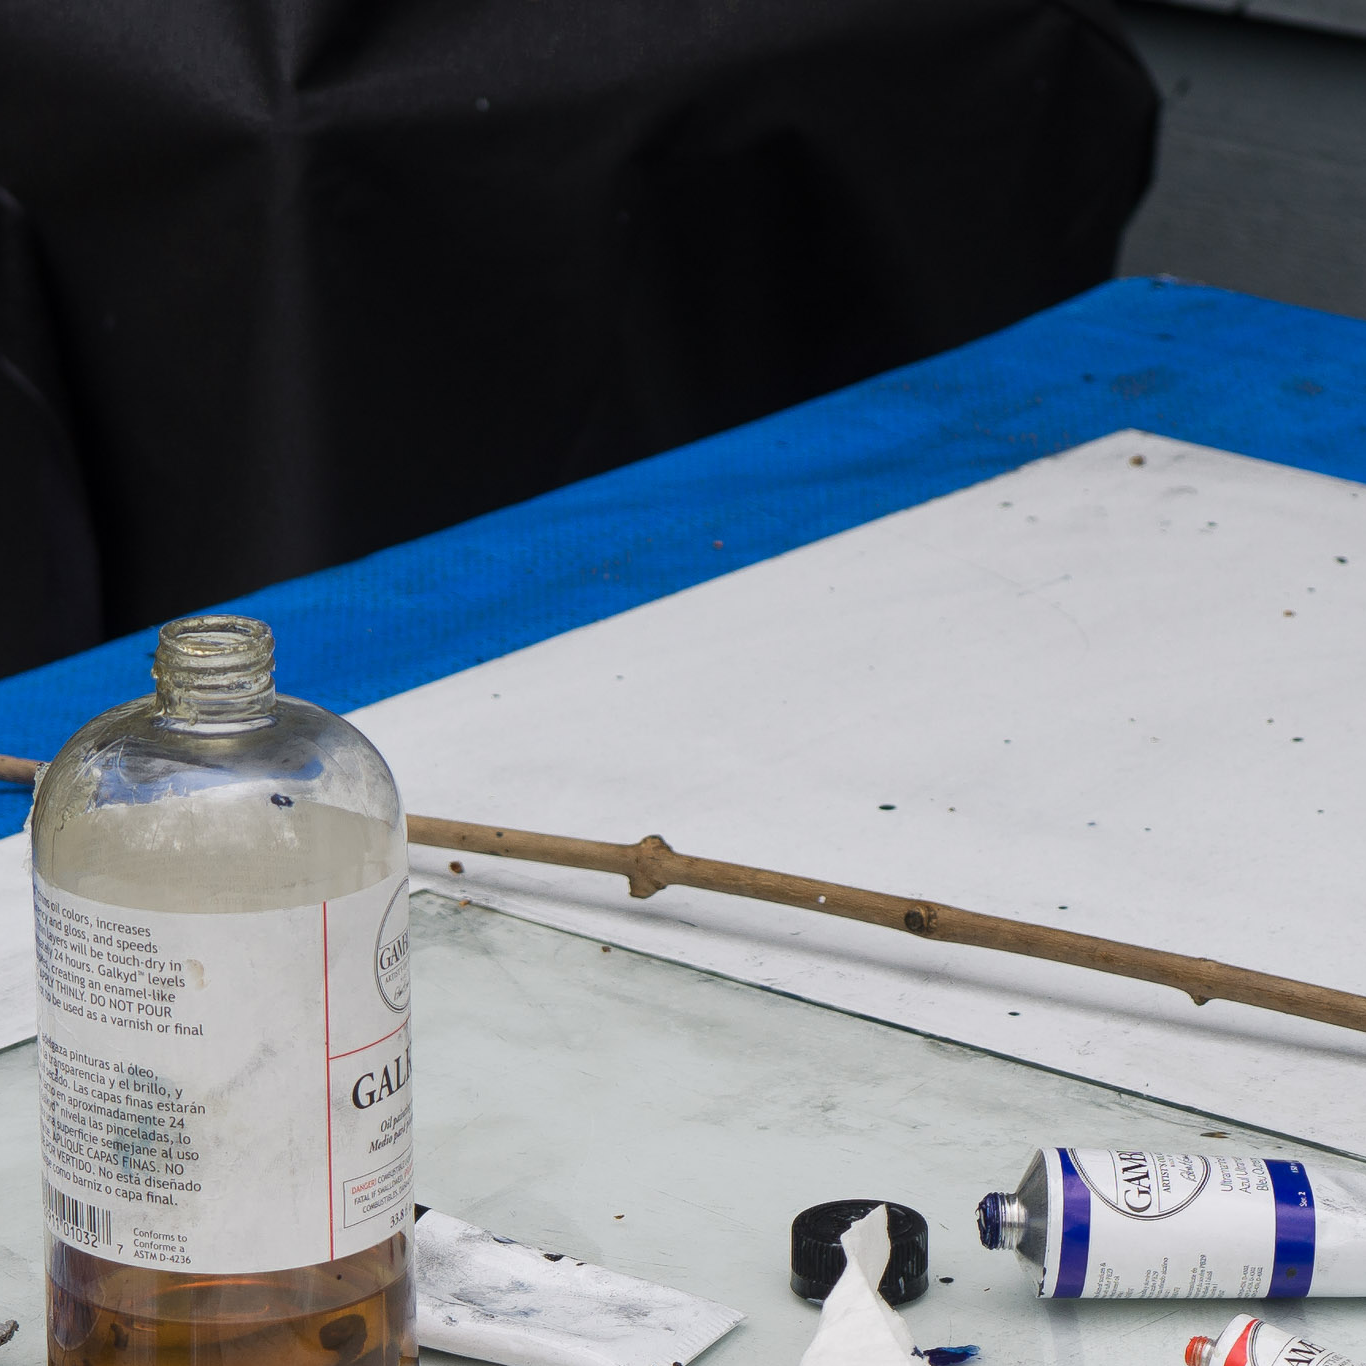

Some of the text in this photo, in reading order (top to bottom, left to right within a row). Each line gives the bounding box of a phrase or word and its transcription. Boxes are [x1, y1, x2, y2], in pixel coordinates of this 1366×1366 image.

[49, 915, 61, 930] and
[64, 925, 90, 942] gloss,
[93, 933, 112, 946] and
[117, 939, 158, 954] speeds
[51, 903, 59, 914] oil
[62, 907, 93, 928] colors,
[96, 917, 151, 937] increases
[47, 929, 67, 948] layers
[70, 942, 87, 956] will
[90, 946, 104, 959] be
[107, 952, 165, 973] touch-dry
[170, 960, 182, 971] in
[54, 949, 63, 962] 24
[65, 954, 94, 974] hours.
[148, 975, 185, 987] levels
[51, 966, 176, 1002] creating an enamel-like
[55, 979, 86, 1002] THINLY.
[90, 994, 105, 1006] DO
[109, 999, 133, 1012] NOT
[137, 1003, 172, 1018] POUR
[52, 993, 203, 1036] be used as a varnish or final
[49, 1054, 105, 1084] transparencia
[109, 1079, 115, 1089] y
[119, 1080, 129, 1089] el
[133, 1082, 170, 1098] brillo,
[175, 1088, 182, 1099] y
[69, 1050, 109, 1070] pinturas
[113, 1063, 124, 1073] al
[127, 1063, 158, 1080] óleo,
[57, 1090, 66, 1102] en
[68, 1095, 165, 1127] aproximadamente
[170, 1117, 184, 1129] 24
[73, 1082, 205, 1114] Las capas finas estarán
[57, 1119, 98, 1144] superficie
[102, 1138, 157, 1157] semejane
[161, 1147, 173, 1159] al
[177, 1151, 199, 1160] uso
[61, 1107, 85, 1125] nivela
[89, 1116, 102, 1130] las
[106, 1122, 174, 1145] pinceladas,
[178, 1133, 191, 1144] lo
[380, 1116, 393, 1133] Oil
[53, 1132, 183, 1175] APLIQUE CAPAS FINAS. NO
[369, 1135, 393, 1154] Medio
[53, 1163, 177, 1206] como barniz o capa final.
[58, 1146, 95, 1175] VERTIDO.
[99, 1167, 112, 1179] No
[117, 1172, 141, 1185] está
[145, 1176, 201, 1192] diseñado
[1239, 1177, 1251, 1194] Azul
[354, 1194, 369, 1205] FATAL
[117, 1244, 123, 1255] 7
[133, 1228, 187, 1242] Conforms to
[133, 1239, 176, 1252] Conforme
[133, 1250, 191, 1264] ASTM D-4236
